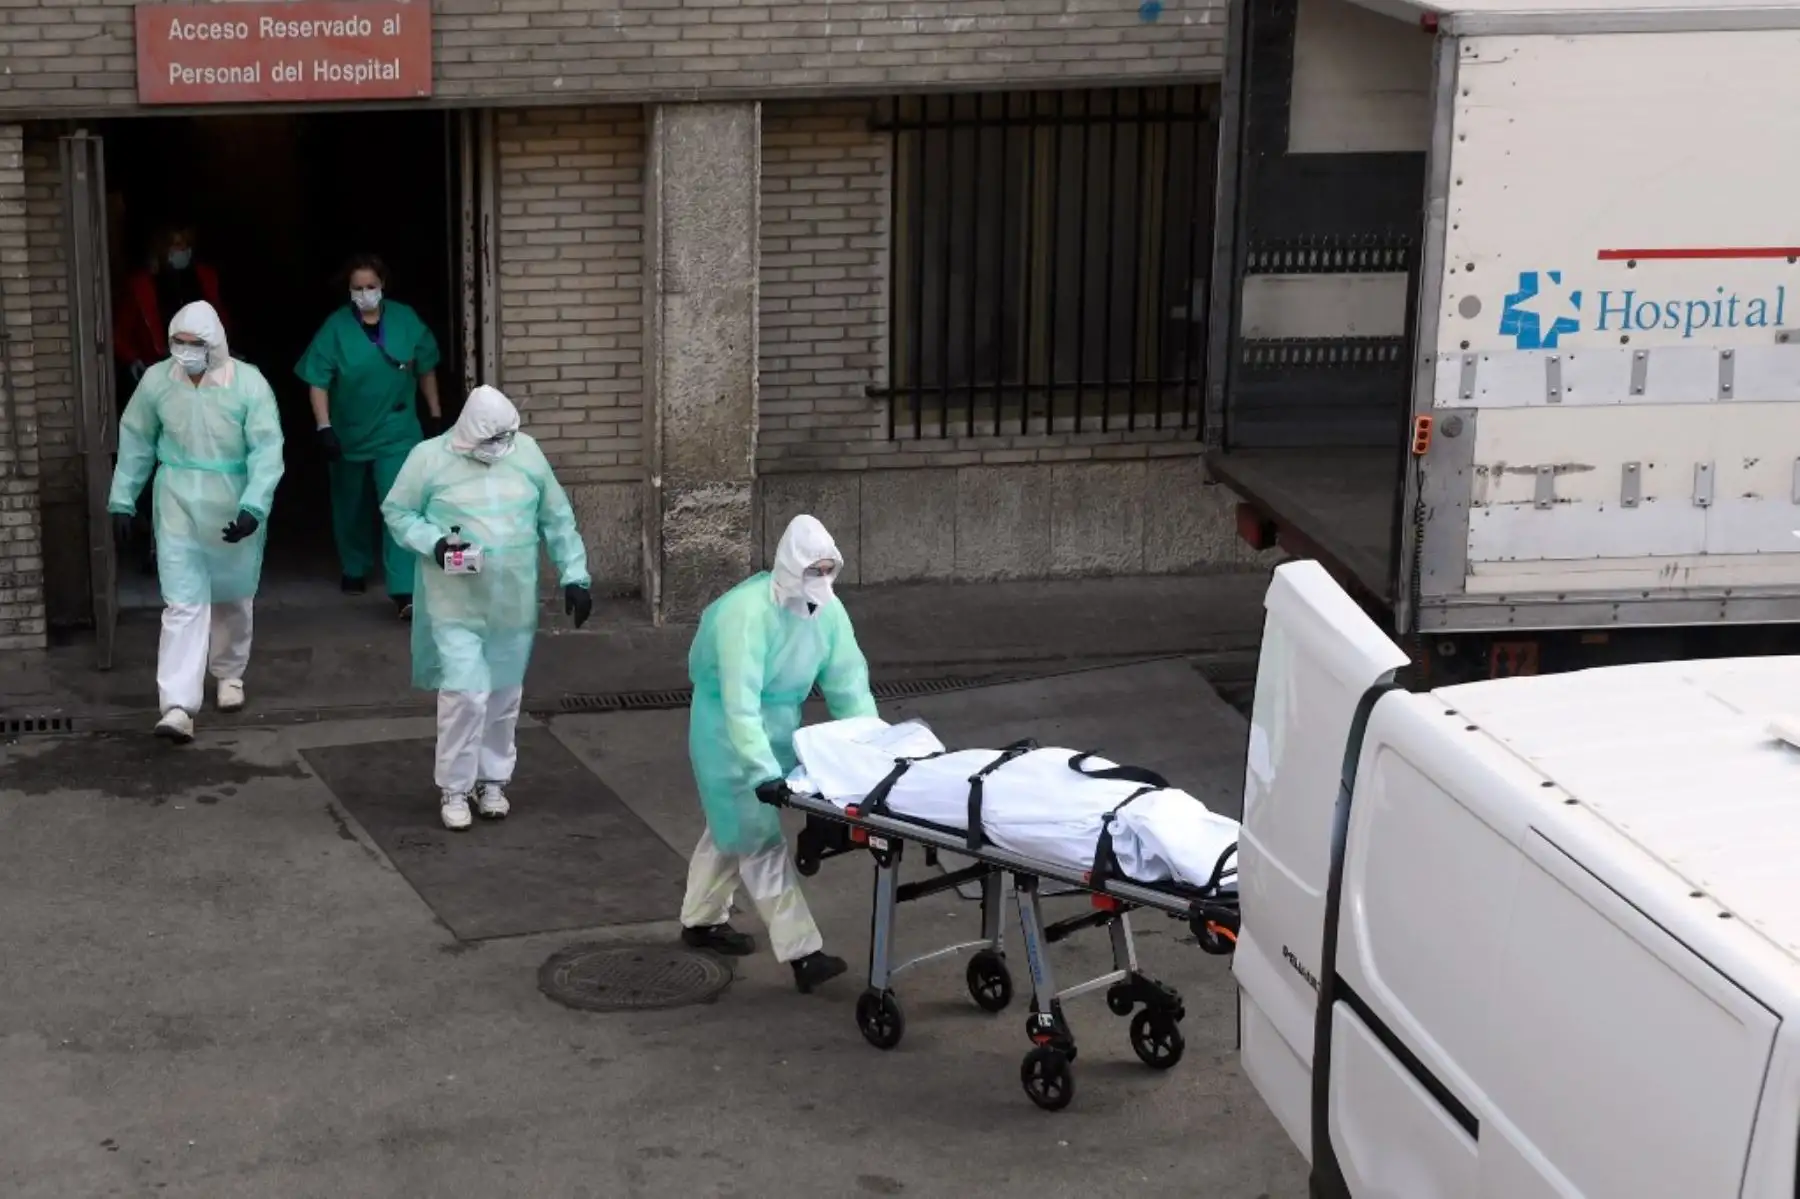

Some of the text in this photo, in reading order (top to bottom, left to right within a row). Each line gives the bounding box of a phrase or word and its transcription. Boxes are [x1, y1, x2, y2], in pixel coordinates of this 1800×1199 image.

[169, 13, 400, 40] Acceso Reservado al
[169, 57, 400, 85] Personal del Hospital
[1595, 285, 1785, 338] Hospital
